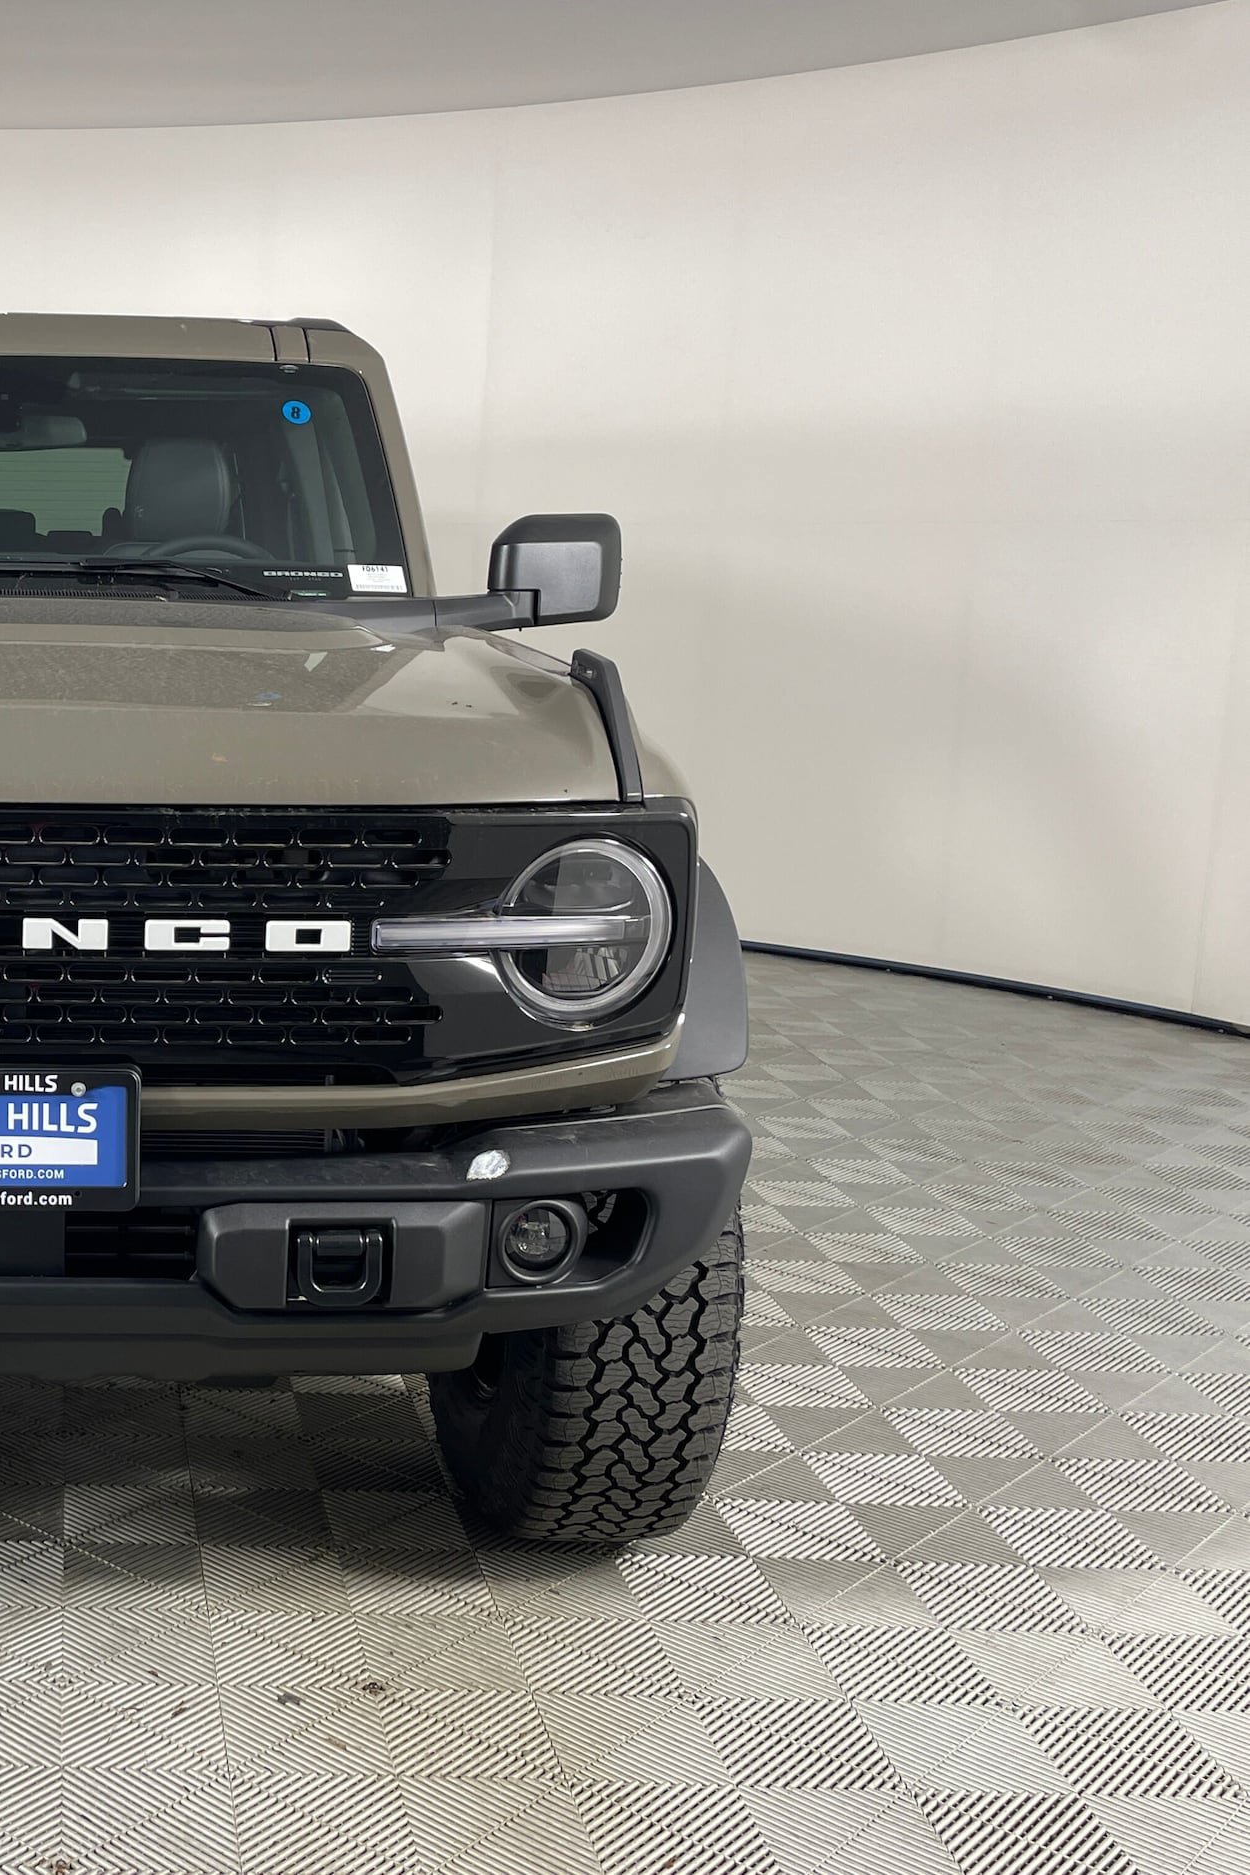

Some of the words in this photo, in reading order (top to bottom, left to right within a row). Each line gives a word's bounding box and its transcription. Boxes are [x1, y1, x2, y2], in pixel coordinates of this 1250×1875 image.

[291, 406, 301, 419] 8
[4, 1075, 58, 1093] HILLS
[7, 1102, 99, 1134] HILLS
